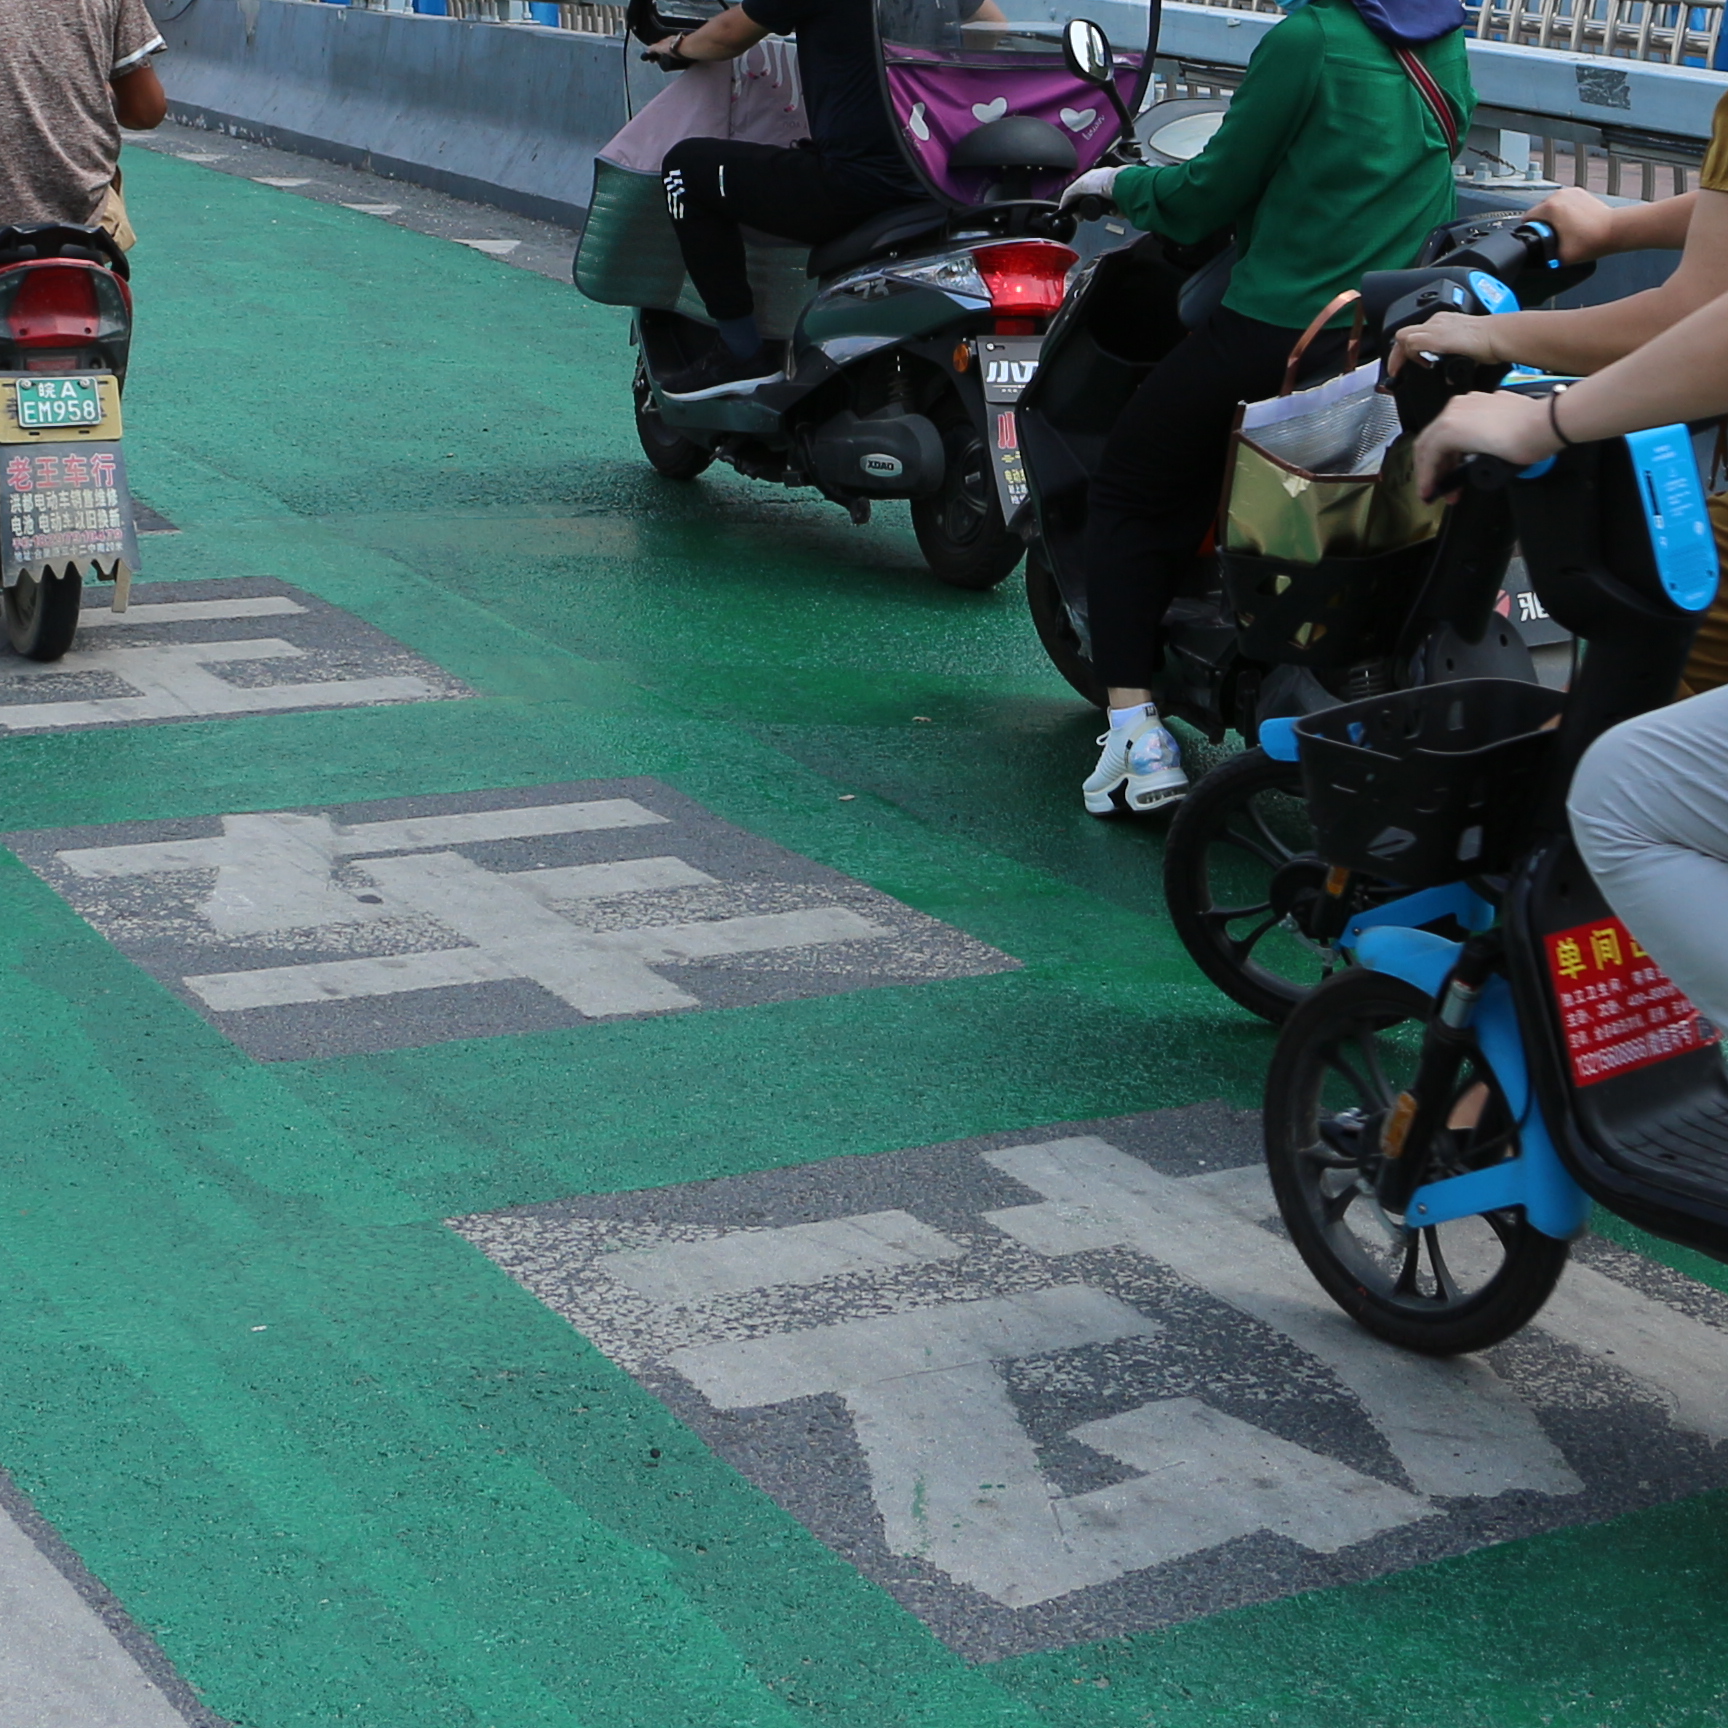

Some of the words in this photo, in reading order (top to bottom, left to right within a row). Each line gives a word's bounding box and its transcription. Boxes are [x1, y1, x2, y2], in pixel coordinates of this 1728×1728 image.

[60, 382, 77, 398] A
[23, 399, 97, 423] EM958
[6, 452, 116, 492] 老王车行
[11, 514, 35, 537] 电池
[57, 797, 879, 1021] 车
